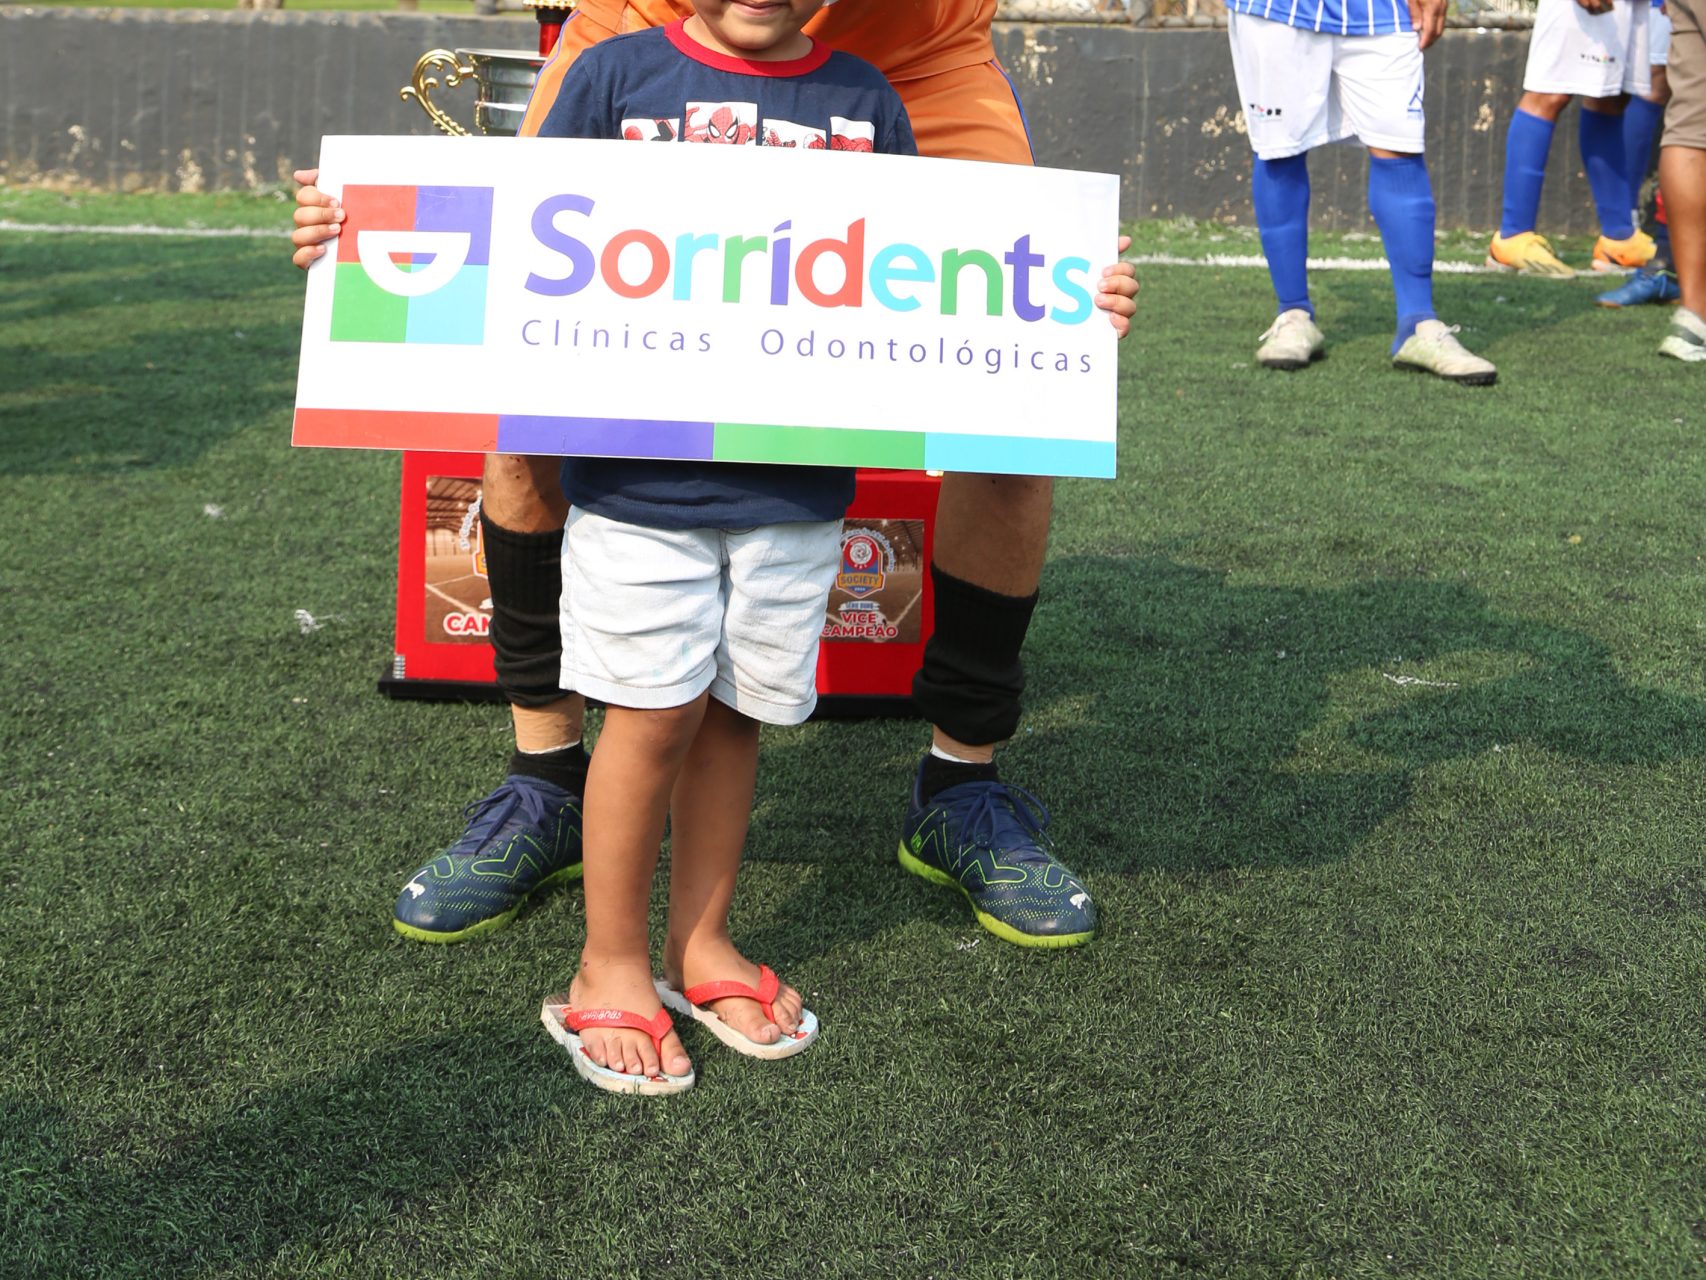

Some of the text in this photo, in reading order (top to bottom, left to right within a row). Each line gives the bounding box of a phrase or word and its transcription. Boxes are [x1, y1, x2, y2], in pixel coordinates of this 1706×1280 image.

[521, 319, 1092, 375] Clínicas Odontológicas
[841, 573, 879, 586] SOCIETY
[841, 611, 877, 624] VICE
[821, 624, 897, 637] CAMPEÃO
